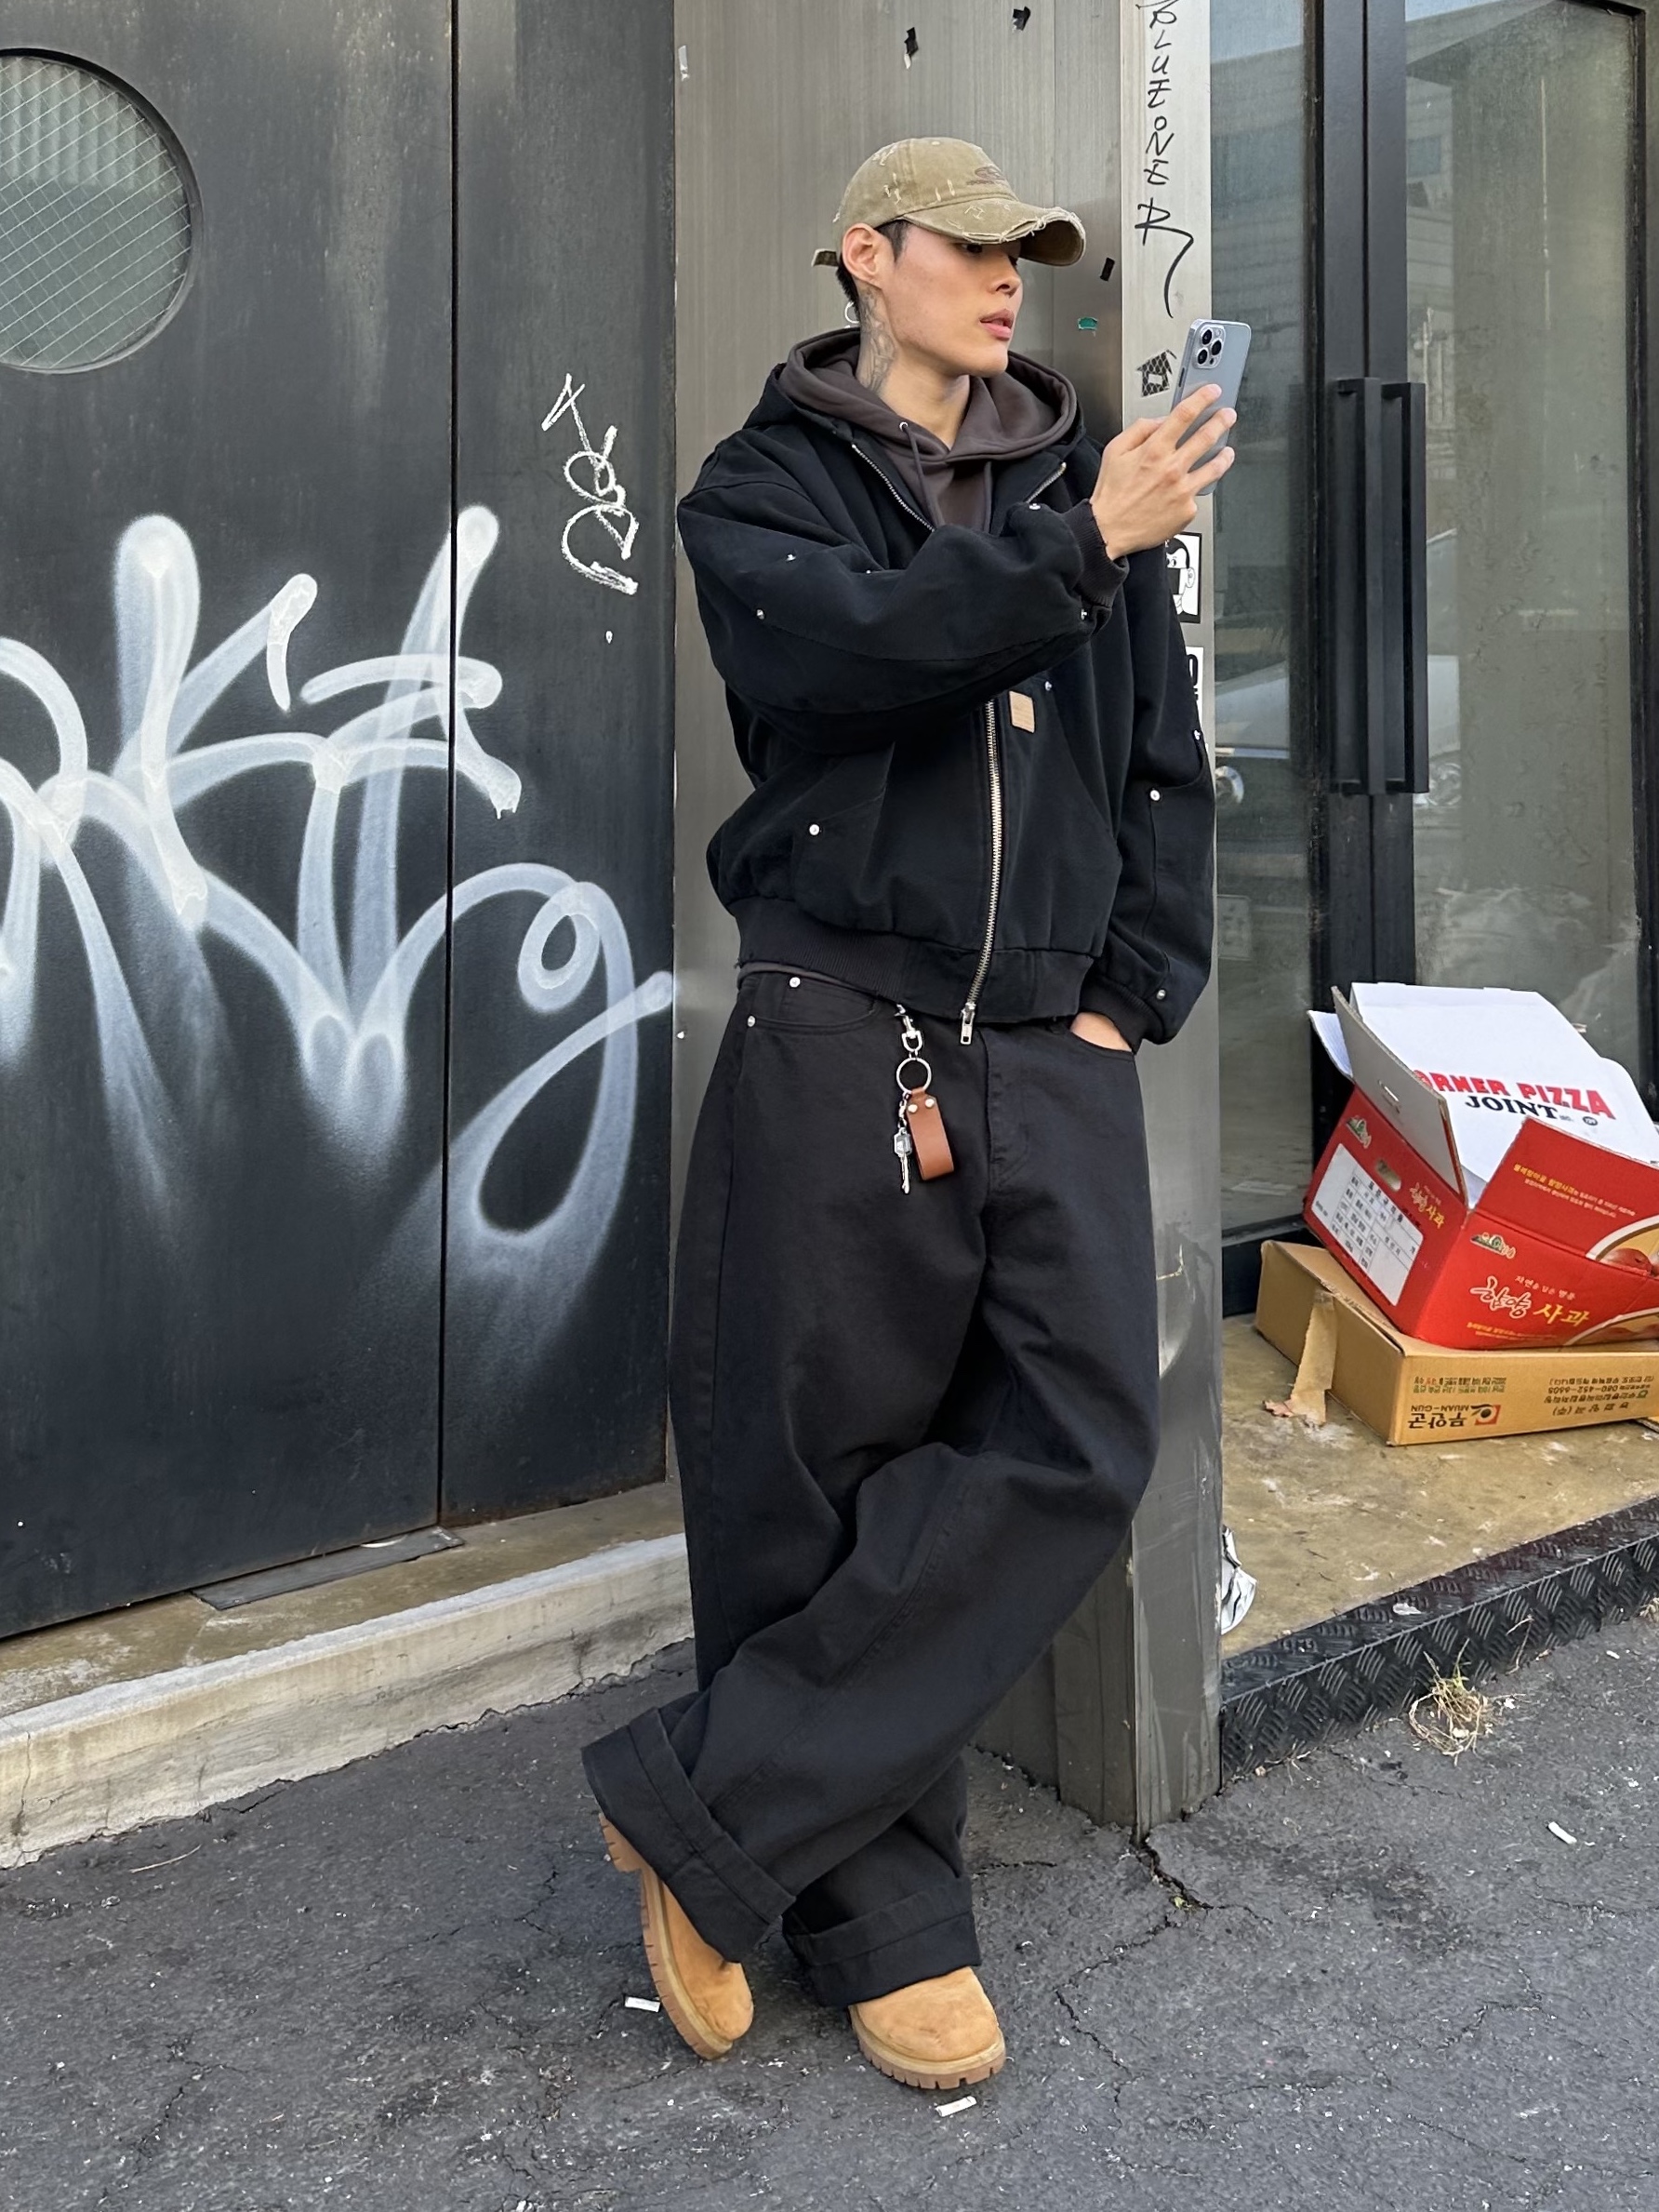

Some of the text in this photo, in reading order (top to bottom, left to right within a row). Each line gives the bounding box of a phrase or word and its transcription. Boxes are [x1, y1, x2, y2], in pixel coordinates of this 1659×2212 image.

[1413, 1070, 1616, 1120] ORNER PIZZA
[1465, 1096, 1559, 1119] JOINT
[1533, 1303, 1590, 1327] 사과
[1408, 1412, 1467, 1429] 무안군
